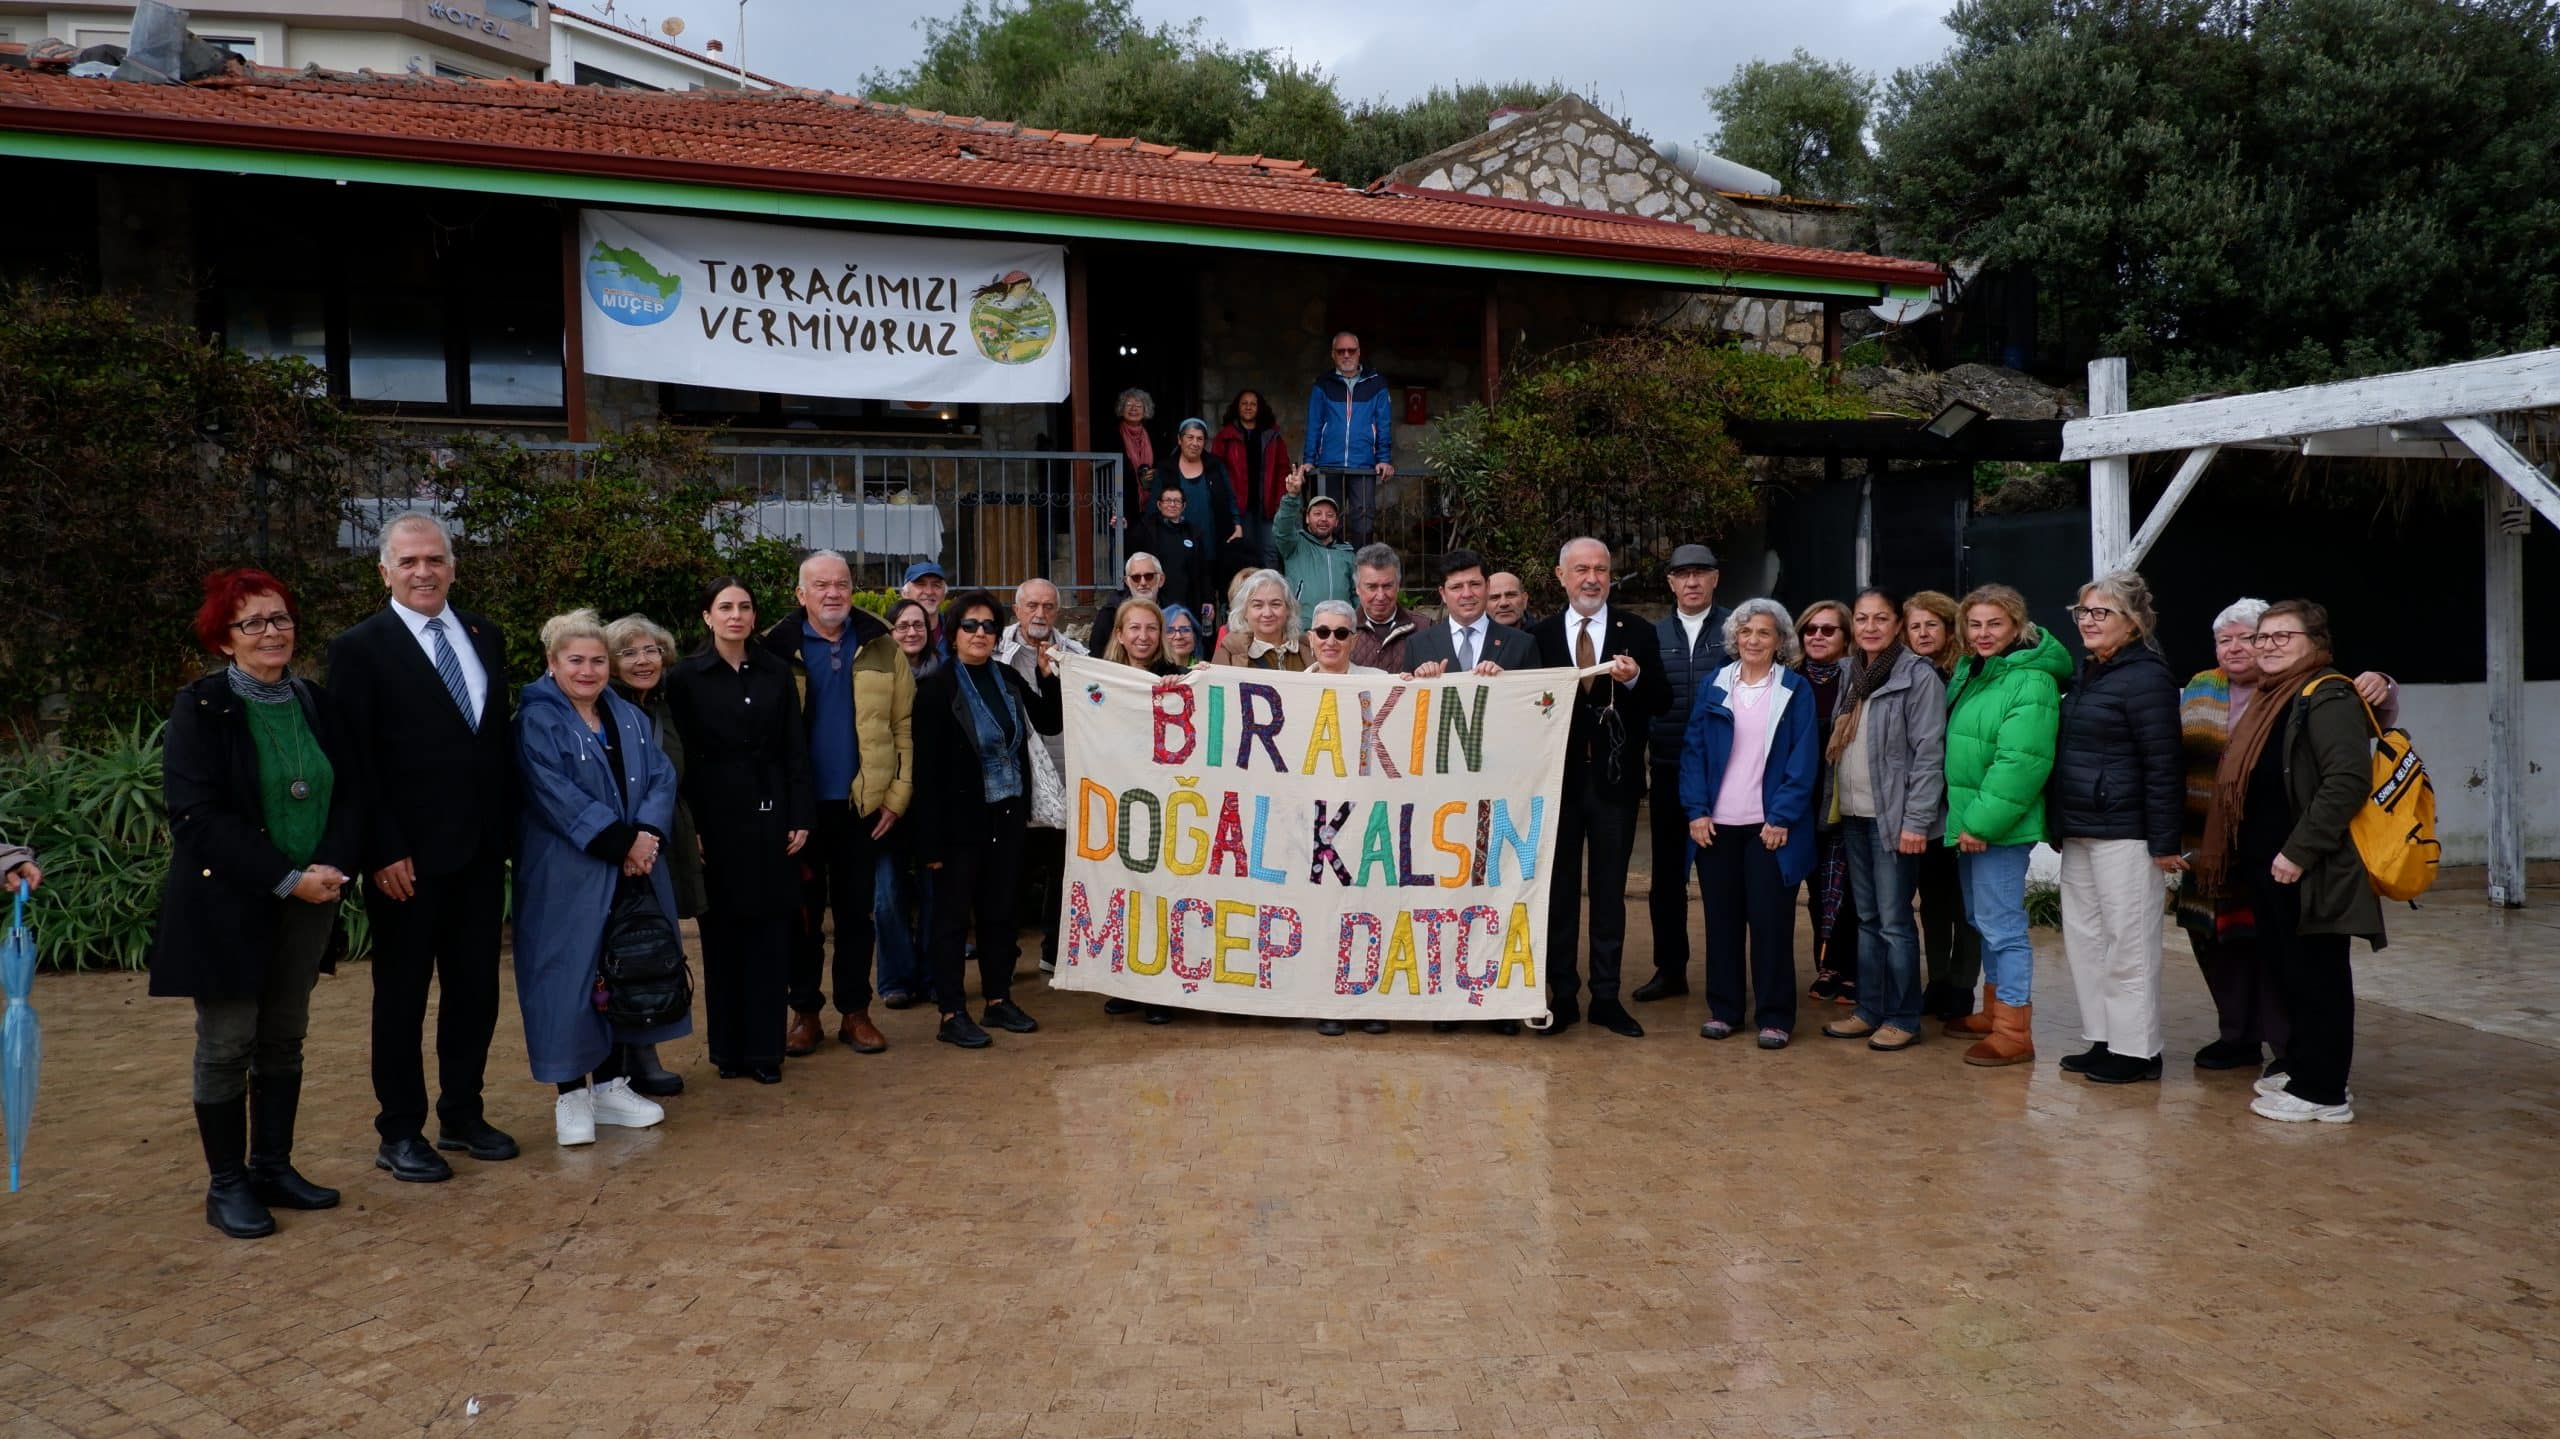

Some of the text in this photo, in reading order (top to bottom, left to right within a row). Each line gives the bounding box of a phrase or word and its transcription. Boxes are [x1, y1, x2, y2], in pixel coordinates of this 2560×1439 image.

[602, 294, 664, 314] MUÇEP
[699, 260, 958, 313] TOPRAĞIMIZI
[699, 306, 959, 356] VERMİYORUZ
[1152, 682, 1489, 778] BIRAKIN
[1076, 776, 1544, 888] DOĞAL KALSIN
[1067, 880, 1536, 1006] MUÇEP DATÇA
